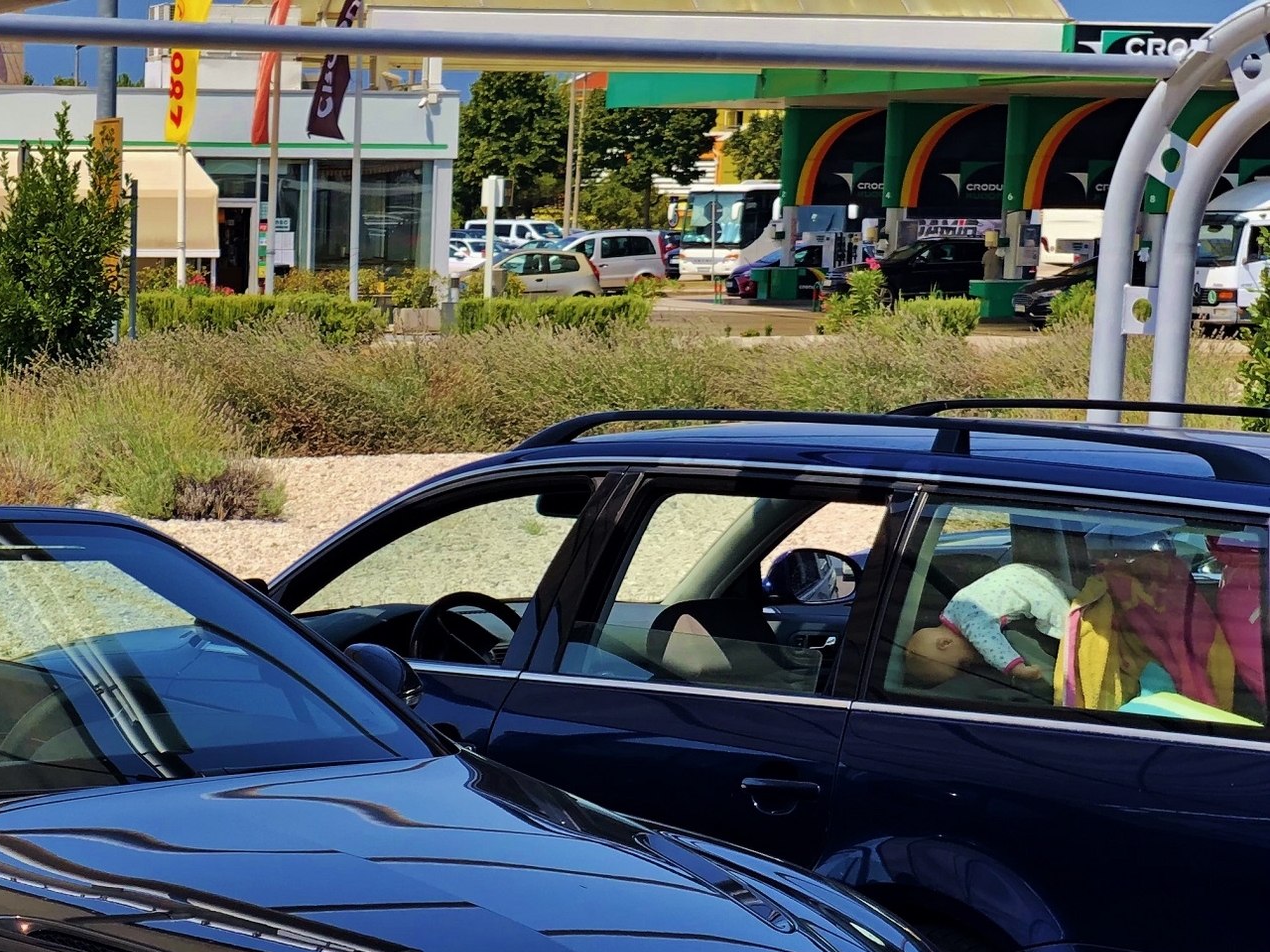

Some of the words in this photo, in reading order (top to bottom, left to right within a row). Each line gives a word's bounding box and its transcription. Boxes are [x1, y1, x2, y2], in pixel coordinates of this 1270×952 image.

[885, 191, 891, 199] 4
[1007, 193, 1014, 201] 6
[1149, 195, 1156, 203] 8
